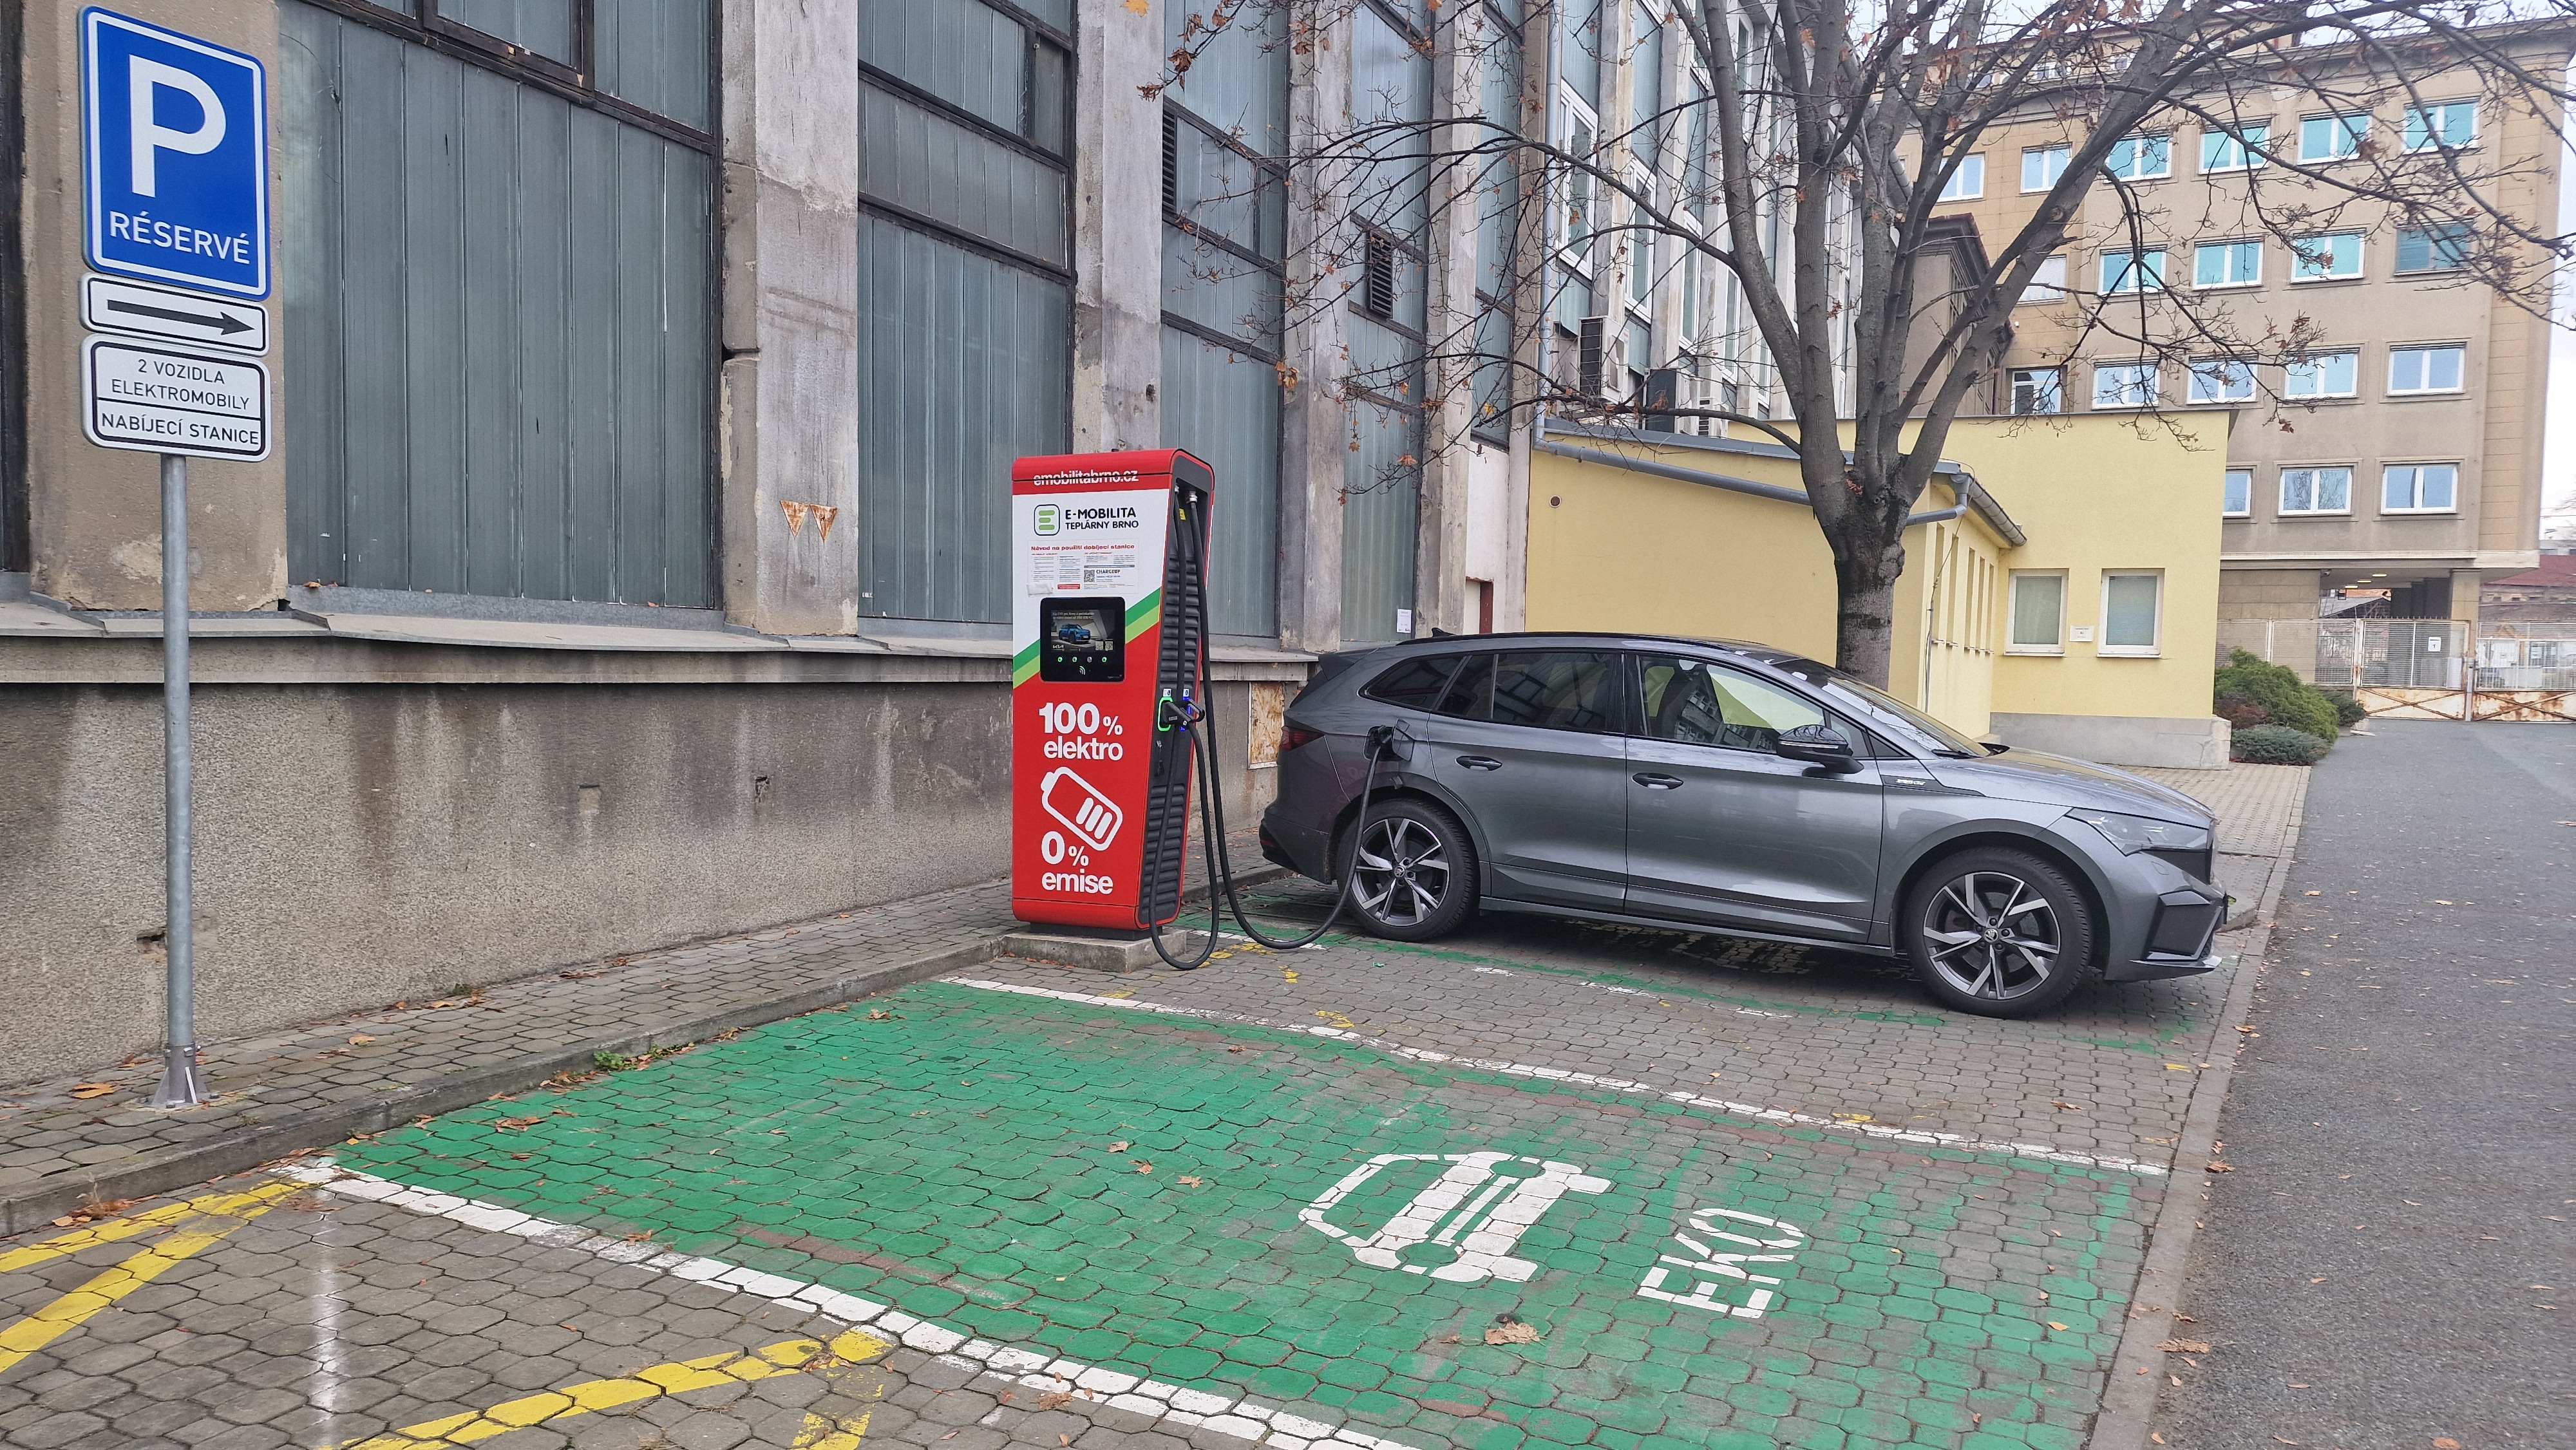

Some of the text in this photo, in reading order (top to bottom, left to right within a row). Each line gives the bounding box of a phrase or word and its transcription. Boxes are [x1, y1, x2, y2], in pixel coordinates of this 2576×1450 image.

[129, 54, 226, 198] P
[109, 211, 250, 265] RÉSERVÉ
[138, 359, 225, 384] 2 VOZIDLA
[111, 379, 250, 411] ELEKTROMOBILY
[102, 414, 259, 445] NABÍJECÍ STANICE
[1033, 469, 1139, 486] emobilitabrno.cz
[1065, 507, 1137, 520] E-MOBILITA
[1065, 520, 1139, 530] TEPLÁRNY BRNO
[1039, 702, 1123, 735] 100 %
[1043, 735, 1123, 761] elektro
[1041, 831, 1089, 867] 0 %
[1041, 869, 1113, 894] emise
[1636, 1208, 1804, 1319] EKO
